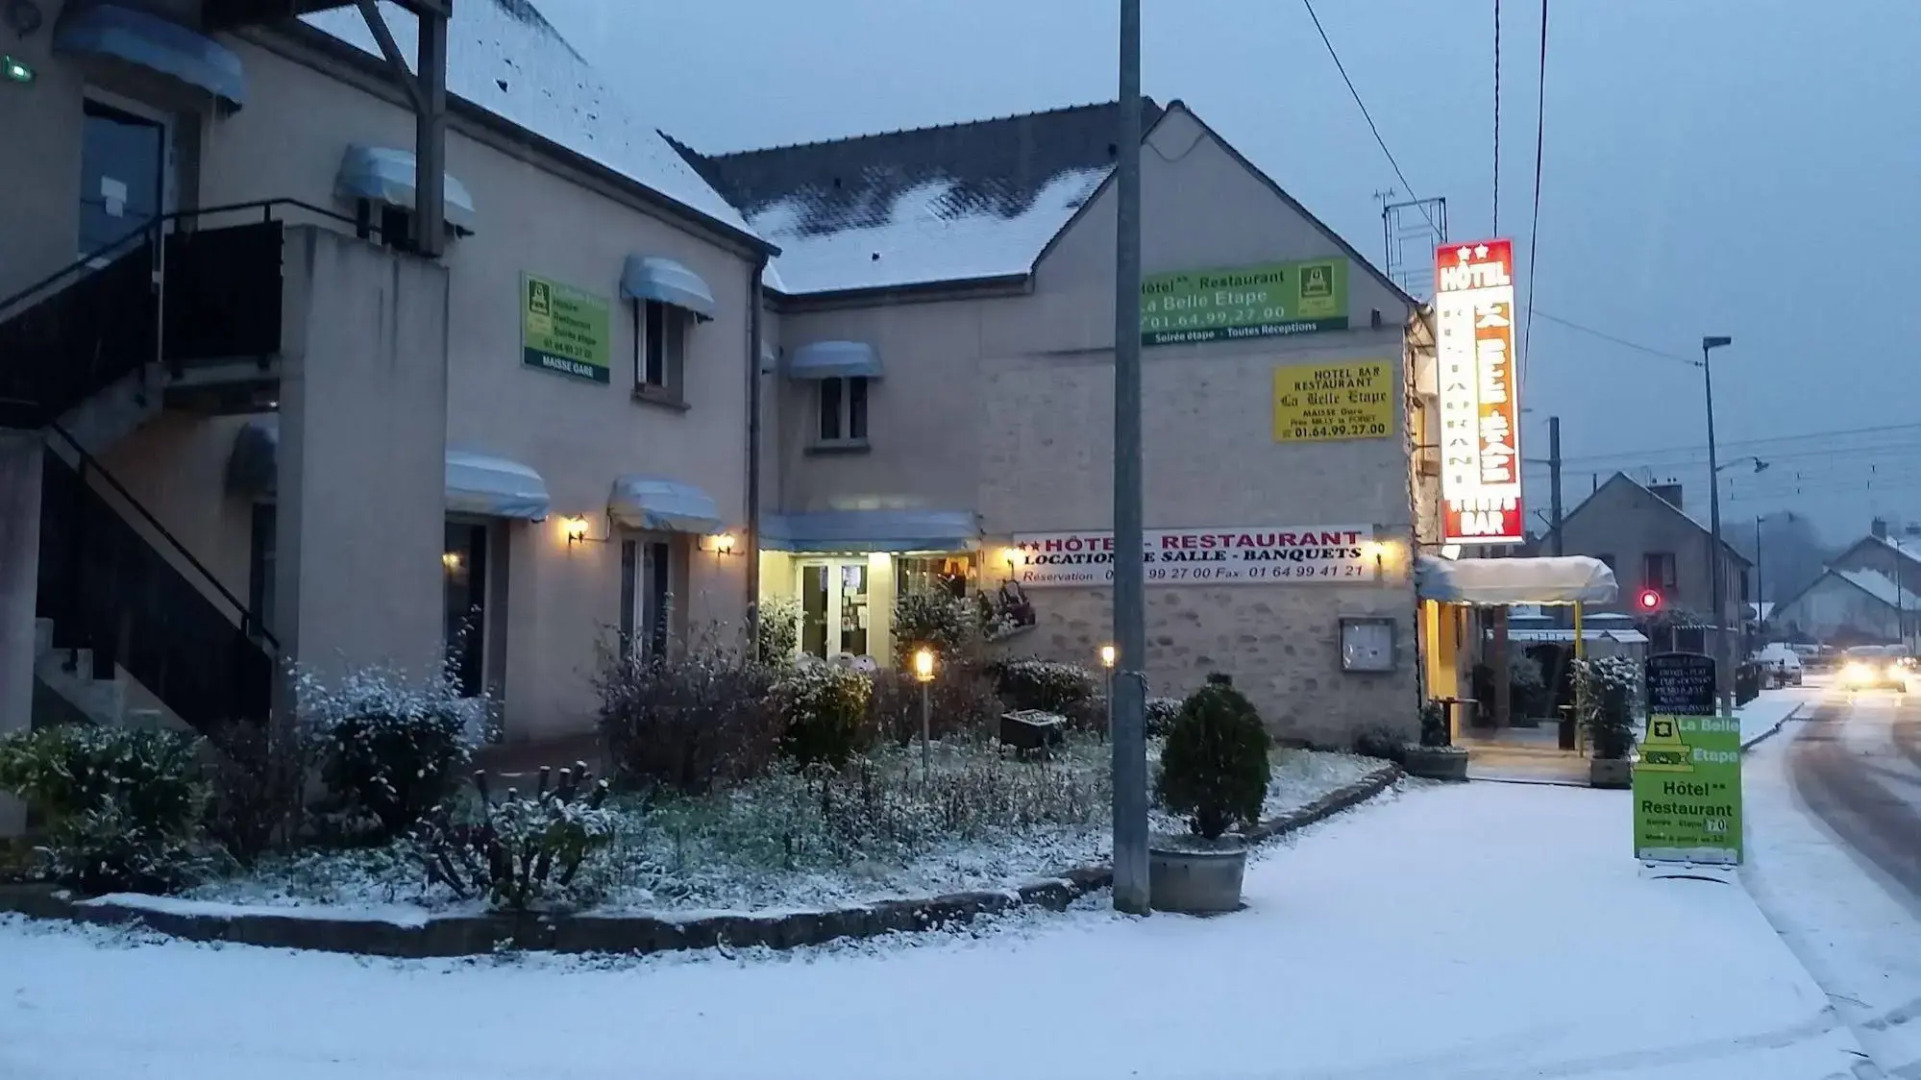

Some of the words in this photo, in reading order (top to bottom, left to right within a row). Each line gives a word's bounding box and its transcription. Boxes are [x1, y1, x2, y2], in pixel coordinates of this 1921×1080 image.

[1199, 270, 1284, 289] Restaurant
[1440, 260, 1511, 292] HÔTEL
[1163, 293, 1208, 311] Belle
[1155, 332, 1186, 343] Soirée
[1227, 326, 1260, 338] Toutes
[1261, 322, 1317, 335] Réceptions
[543, 355, 571, 372] MAISSE
[572, 362, 594, 378] GARE
[1314, 368, 1351, 381] HOTEL
[1359, 366, 1381, 377] BAR
[1294, 378, 1373, 391] RESTAURANT
[1307, 391, 1340, 406] Belle
[1295, 423, 1386, 438] 01.64.99.27.00
[1462, 511, 1503, 535] BAR
[1045, 535, 1115, 552] HÔTE
[1161, 531, 1363, 550] RESTAURANT
[1143, 551, 1155, 563] E
[1160, 550, 1227, 563] SALLE
[1243, 547, 1362, 563] BANQUETS
[1023, 570, 1093, 583] Réservation
[1149, 568, 1166, 580] 99
[1171, 568, 1188, 579] 27
[1193, 568, 1211, 579] 00
[1248, 566, 1266, 578] 01
[1272, 566, 1291, 578] 64
[1296, 565, 1315, 577] 99
[1319, 565, 1338, 576] 41
[1345, 565, 1363, 576] 21
[1679, 718, 1697, 731] La
[1701, 718, 1739, 732] Belle
[1663, 780, 1709, 796] Hôtel
[1641, 800, 1733, 817] Restaurant
